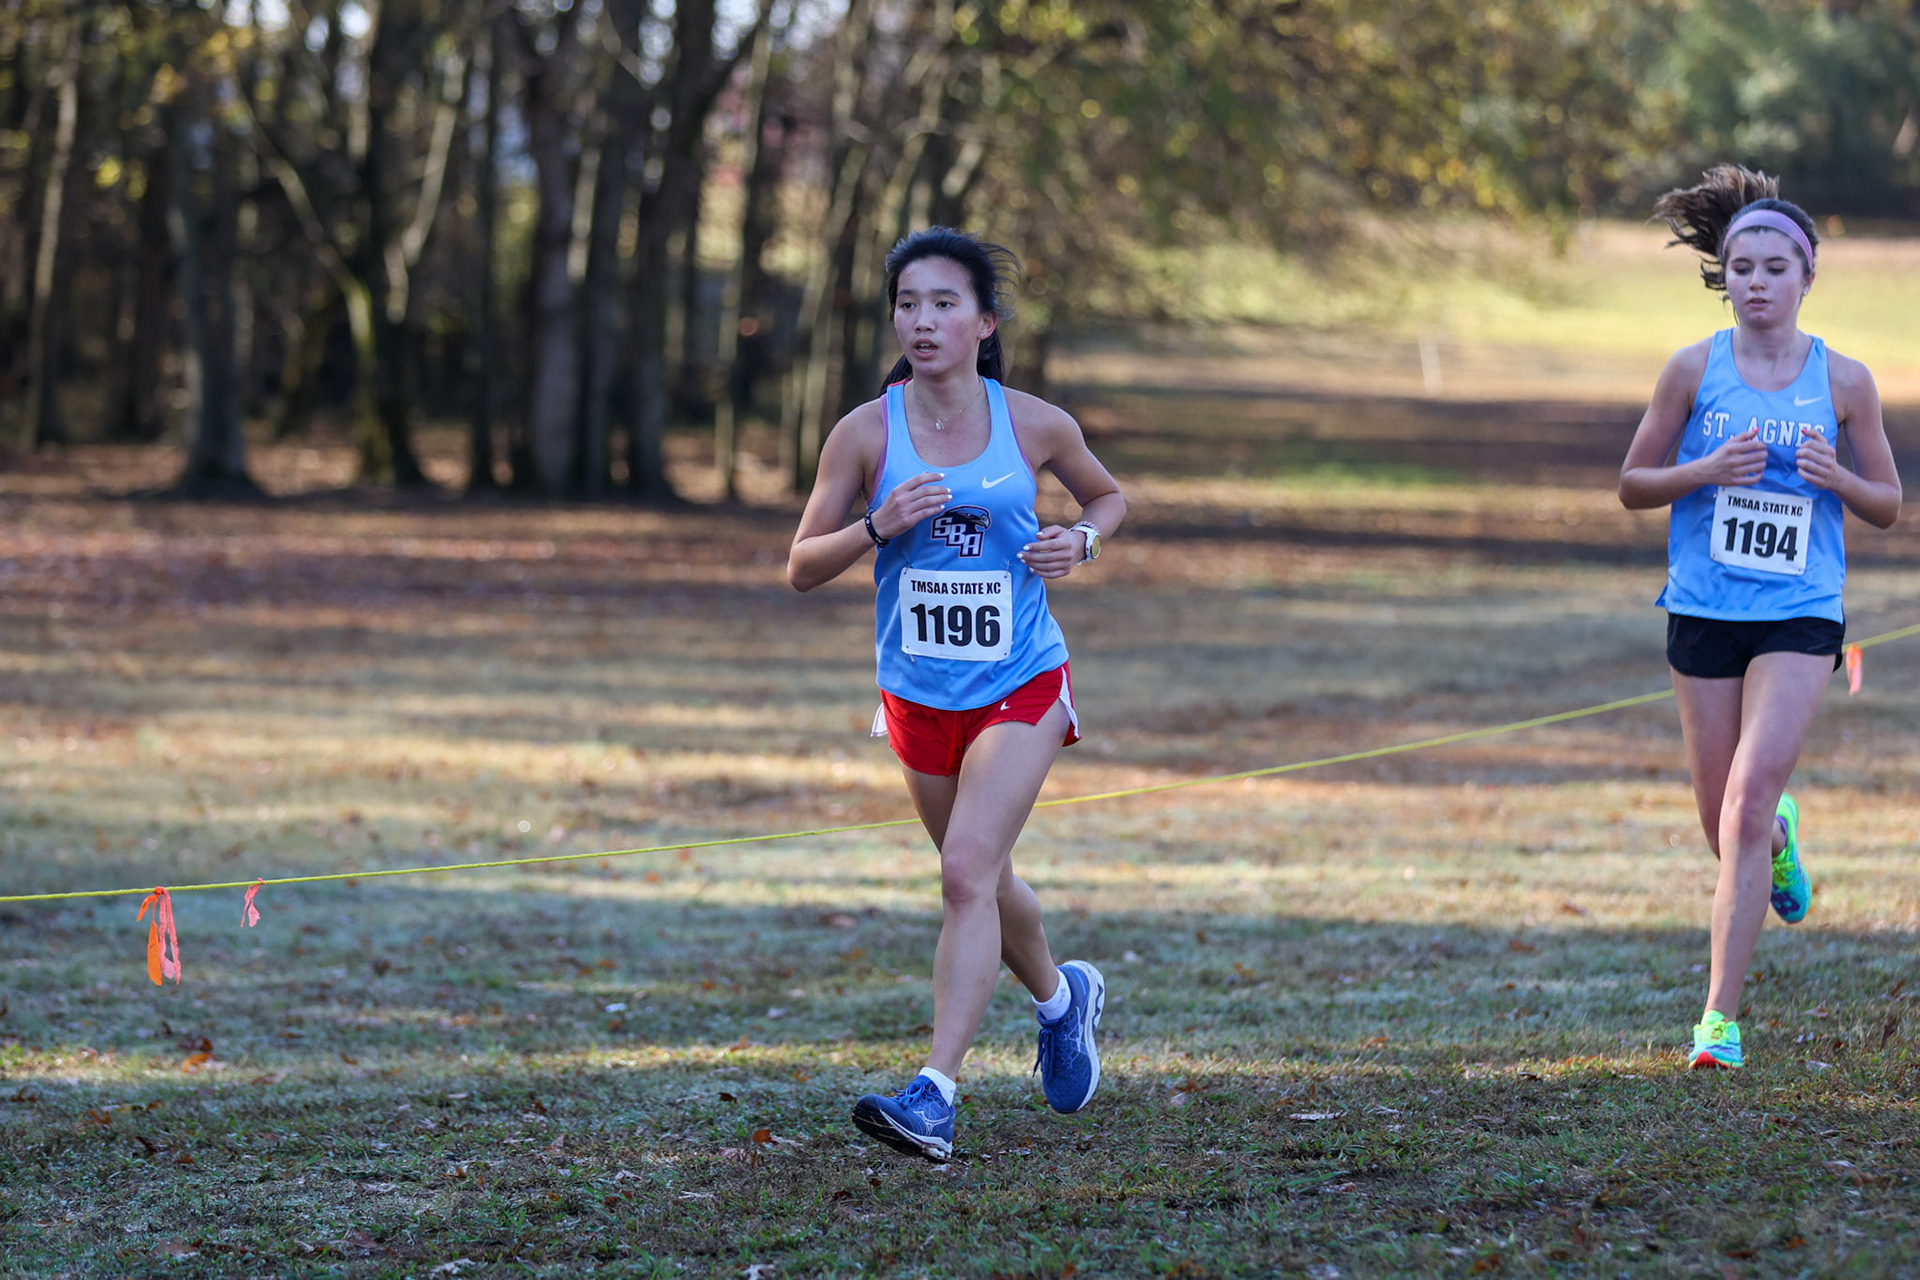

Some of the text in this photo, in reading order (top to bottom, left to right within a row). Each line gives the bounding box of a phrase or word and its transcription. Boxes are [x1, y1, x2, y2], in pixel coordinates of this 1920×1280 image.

[1727, 495, 1803, 517] TMSAA STATE XC
[933, 516, 981, 556] SBA
[1723, 517, 1798, 562] 1194
[910, 579, 1001, 595] TMSAA STATE XC
[910, 603, 1001, 648] 1196
